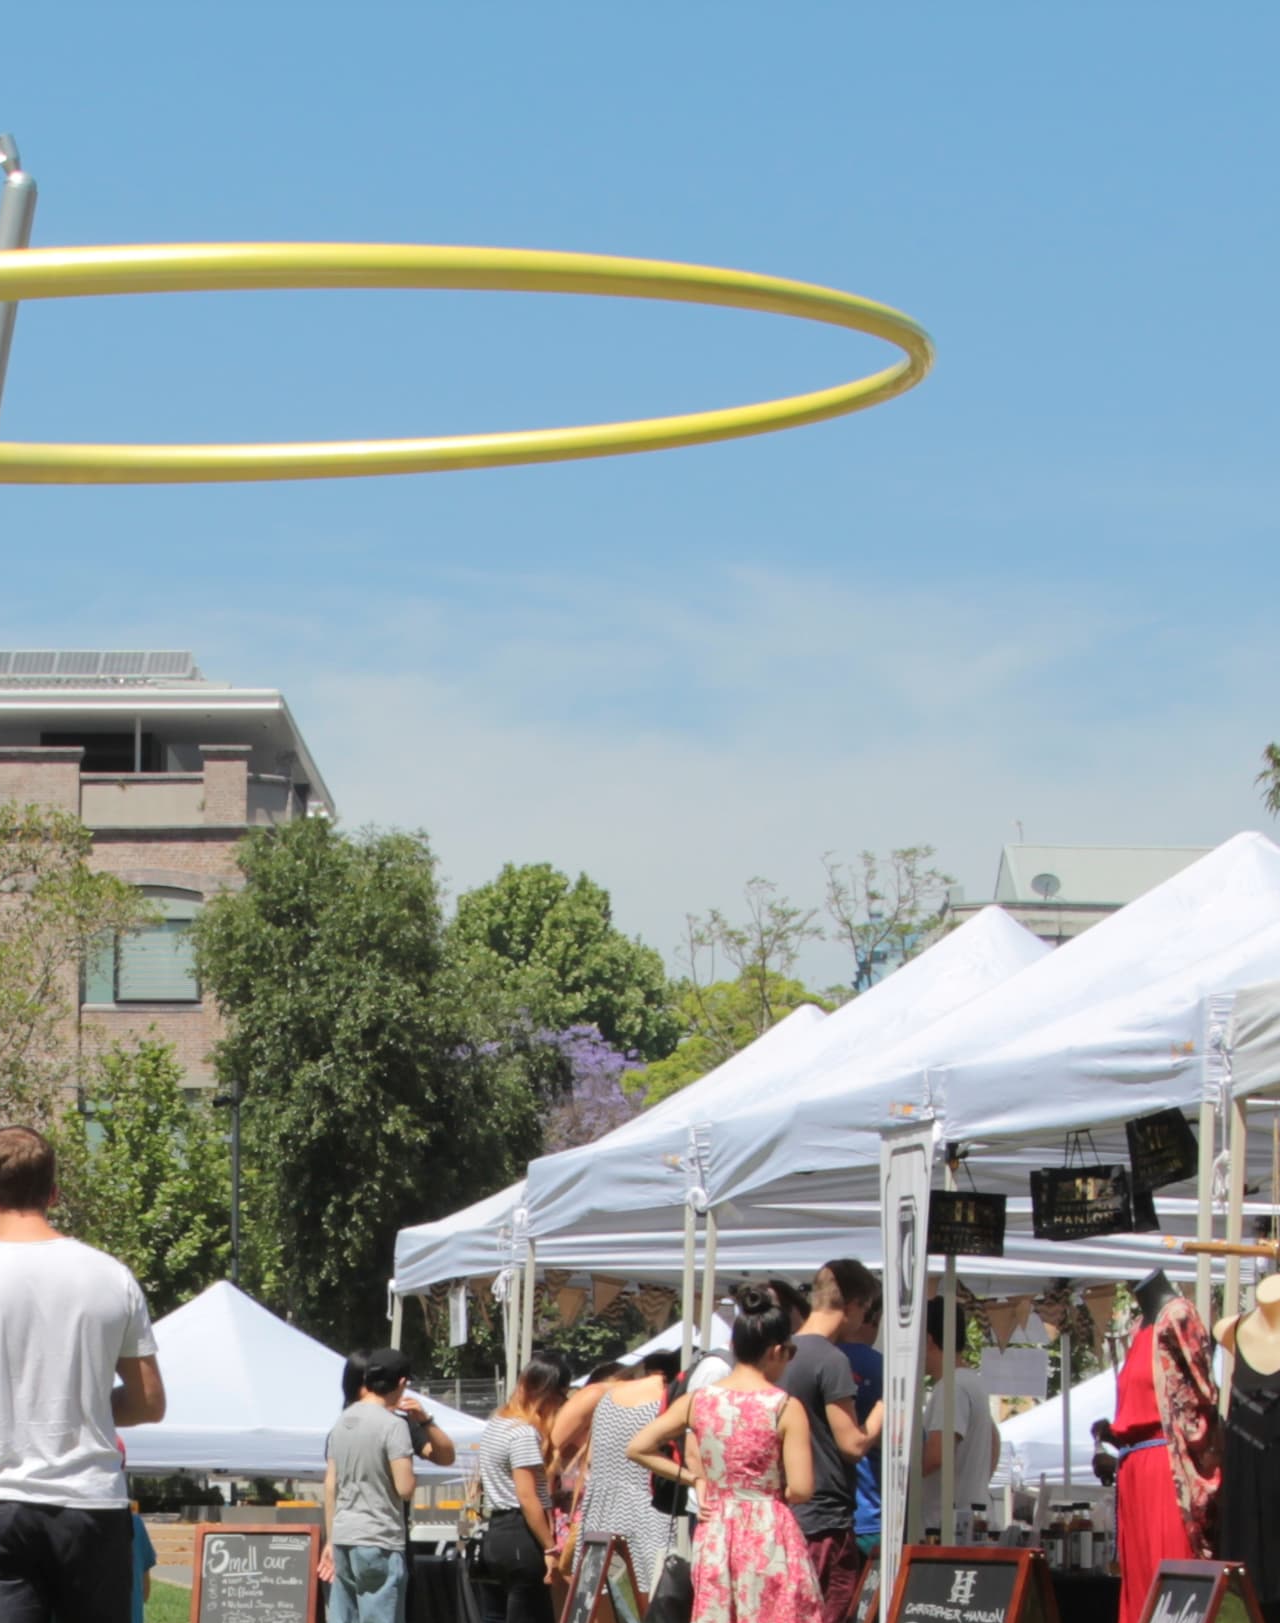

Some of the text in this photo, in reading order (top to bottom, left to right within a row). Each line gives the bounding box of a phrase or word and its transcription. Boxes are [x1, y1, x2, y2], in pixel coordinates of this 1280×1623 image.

[208, 1539, 257, 1574] Smell
[263, 1555, 291, 1571] our
[905, 1603, 962, 1623] CHRISTOPHER
